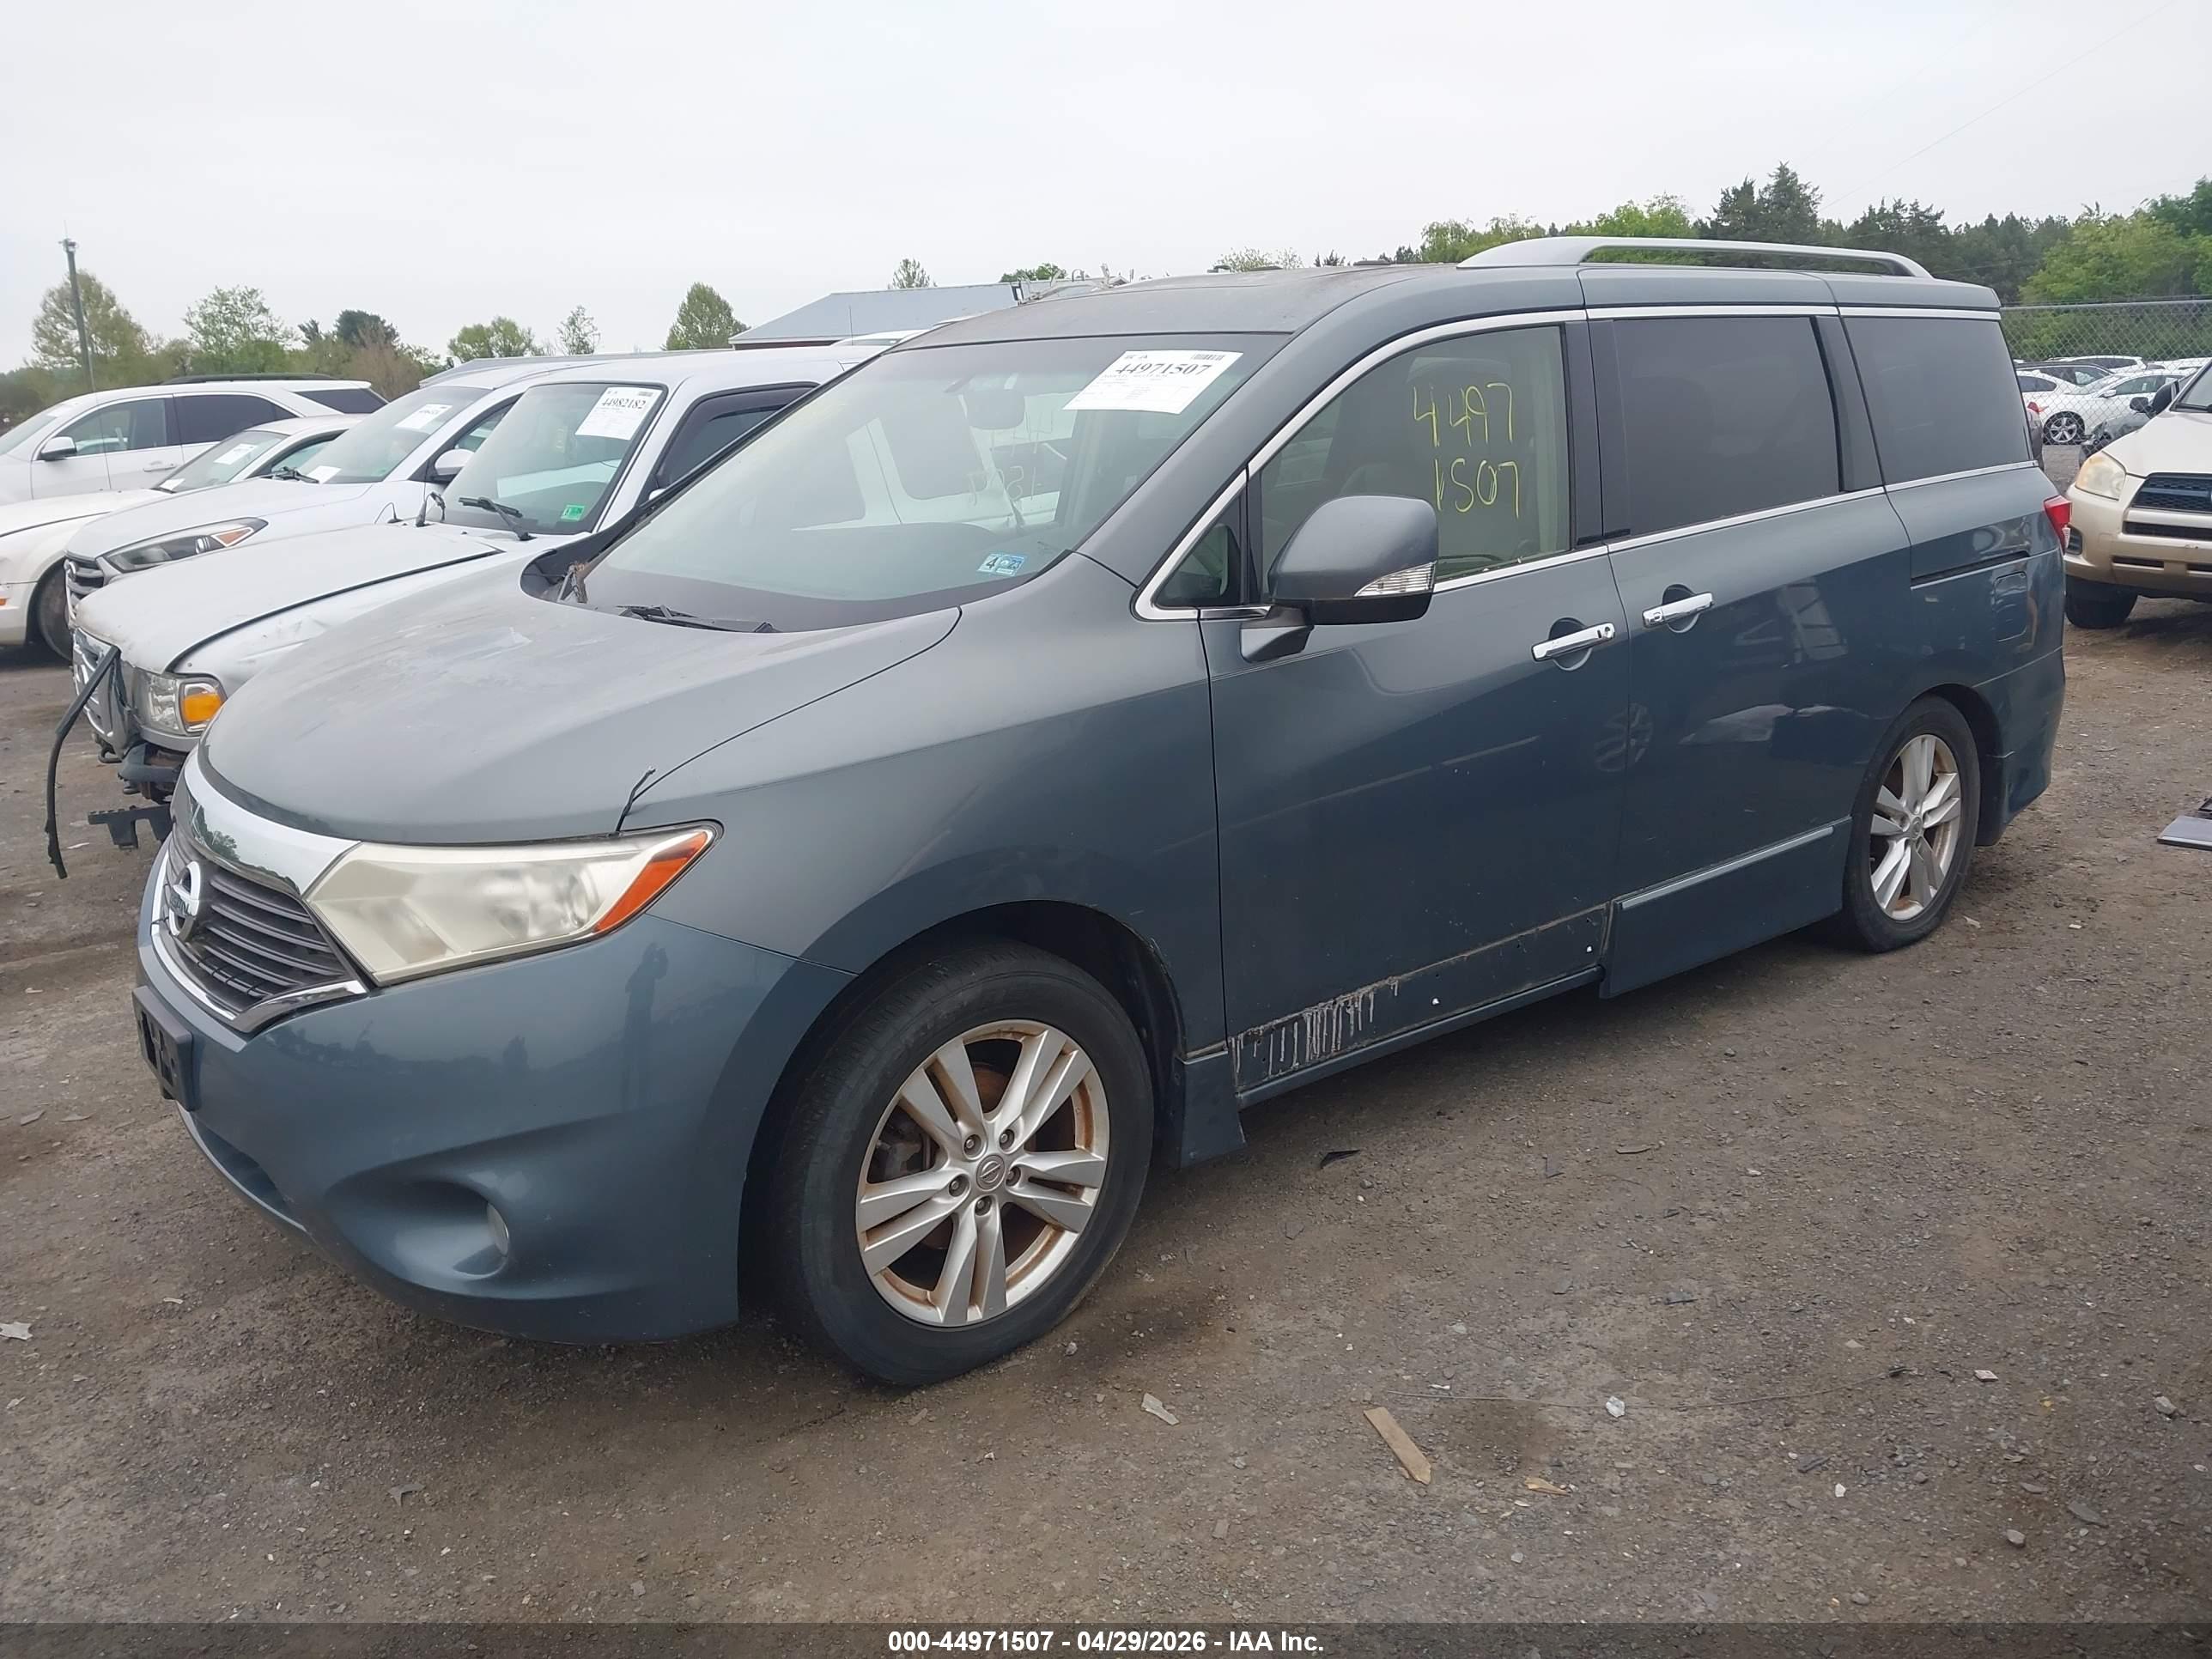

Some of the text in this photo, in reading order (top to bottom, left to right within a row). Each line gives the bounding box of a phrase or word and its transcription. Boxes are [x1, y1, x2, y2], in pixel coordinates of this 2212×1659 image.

[1115, 362, 1212, 376] 44971507
[601, 397, 647, 410] 44982182
[1413, 381, 1514, 447] 4497
[986, 556, 1000, 569] 4
